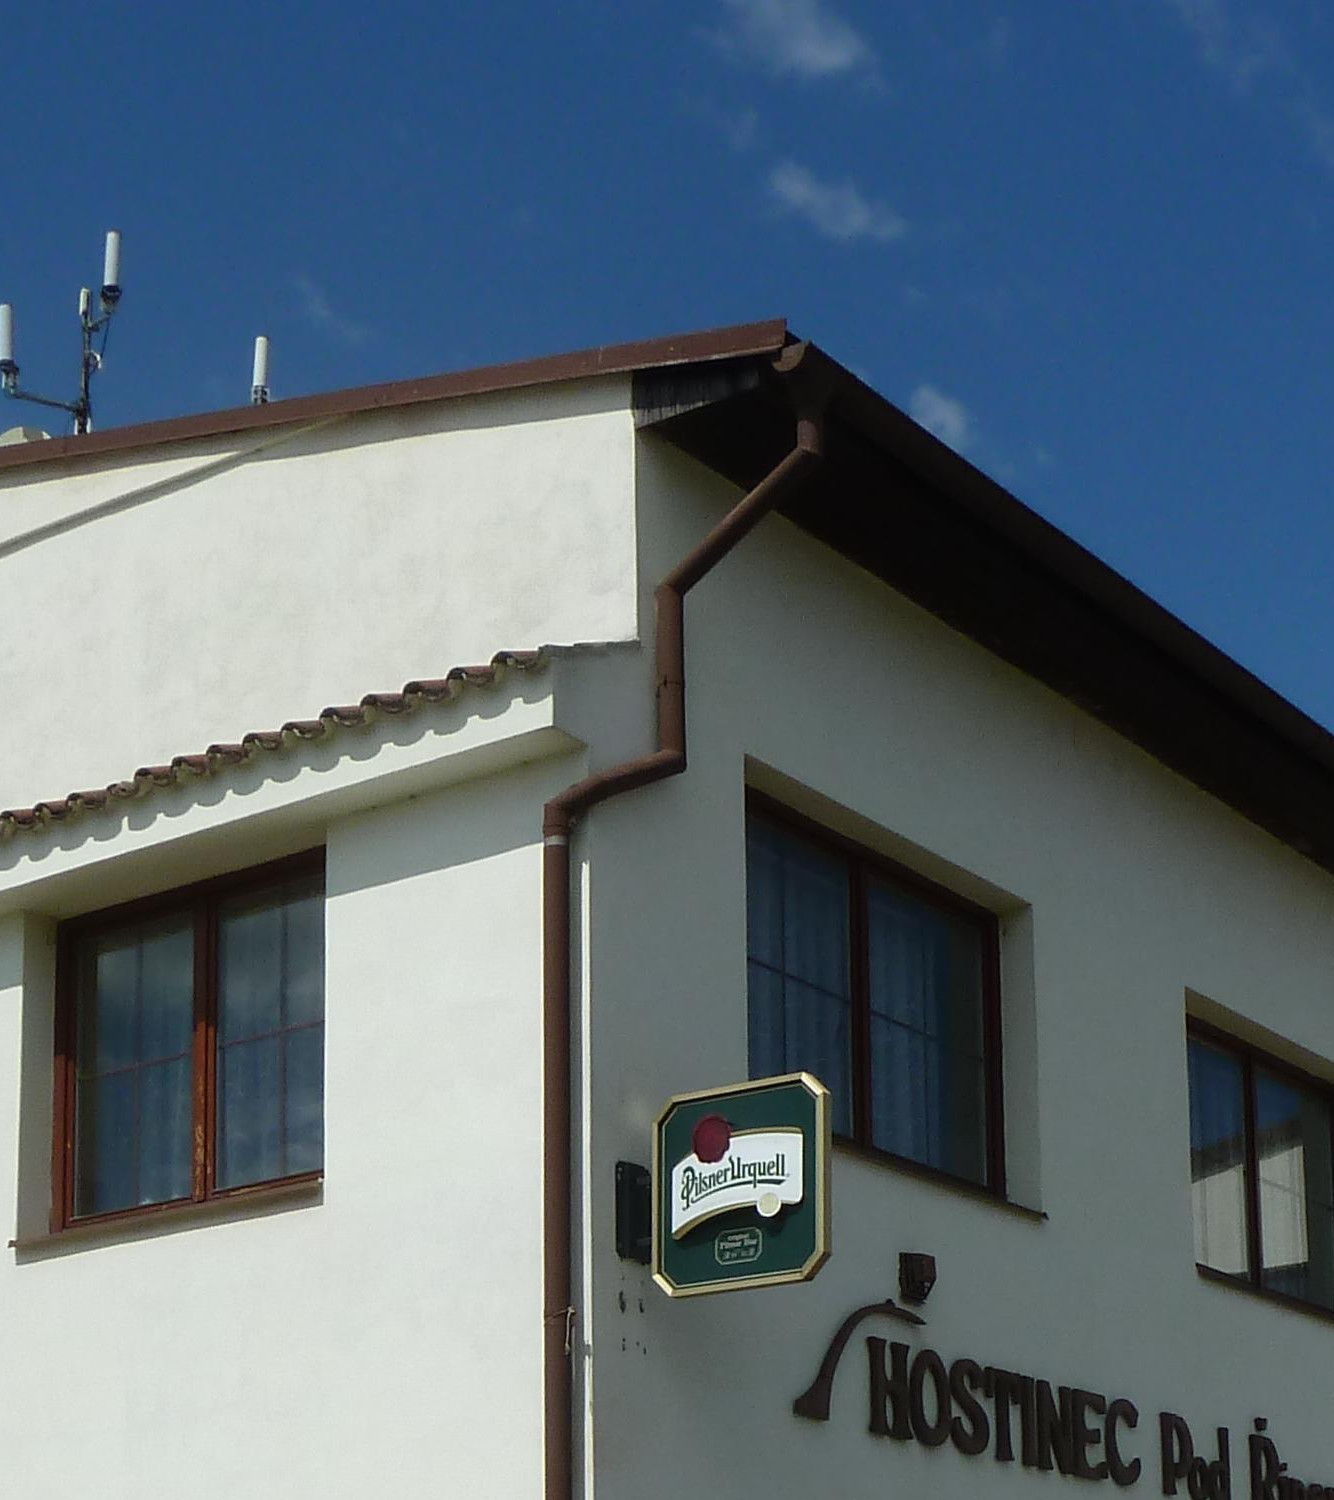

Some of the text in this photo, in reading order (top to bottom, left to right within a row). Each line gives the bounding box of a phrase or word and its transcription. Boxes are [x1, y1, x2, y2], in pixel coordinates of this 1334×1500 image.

[681, 1154, 785, 1210] Pilsner Urquell
[867, 1335, 1142, 1486] HOSTINEC
